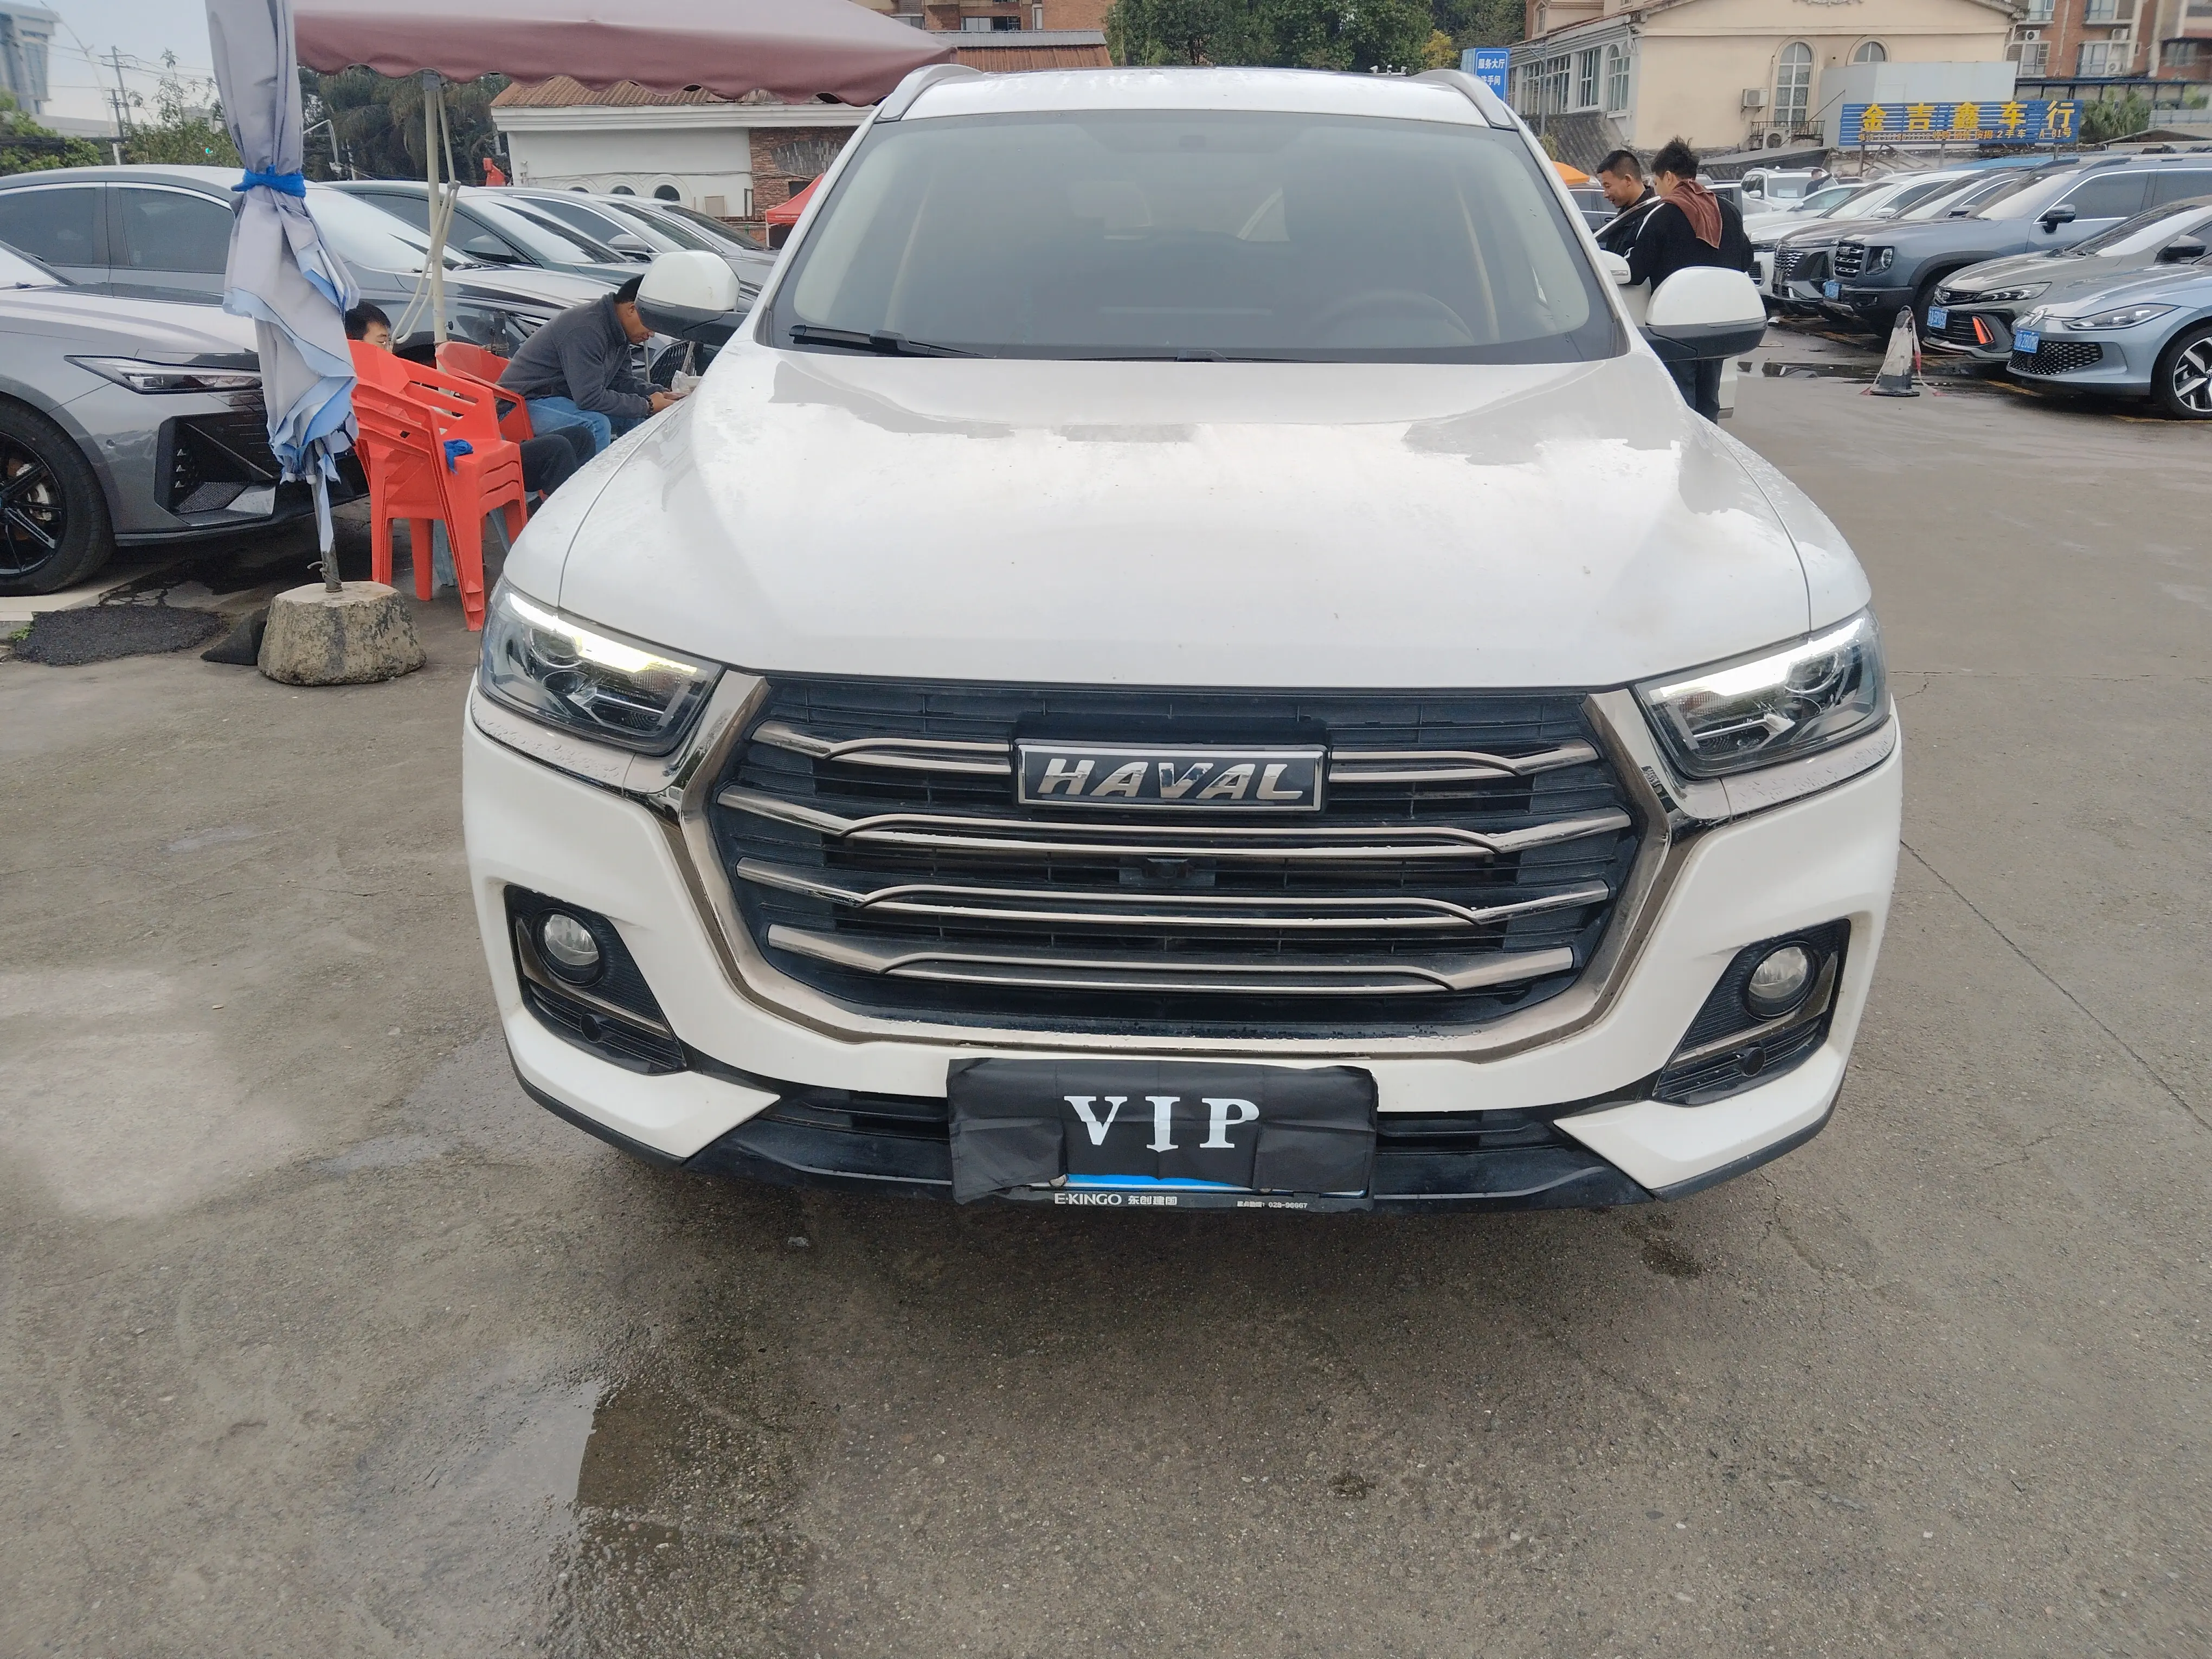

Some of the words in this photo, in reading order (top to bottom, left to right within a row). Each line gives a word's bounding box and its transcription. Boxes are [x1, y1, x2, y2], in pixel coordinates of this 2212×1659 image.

[1478, 58, 1505, 69] 服务大厅
[1860, 100, 2075, 132] 金吉鑫车行
[1038, 758, 1303, 800] HAVAL
[1064, 1096, 1260, 1153] VIP
[1128, 1195, 1178, 1206] 东创建国
